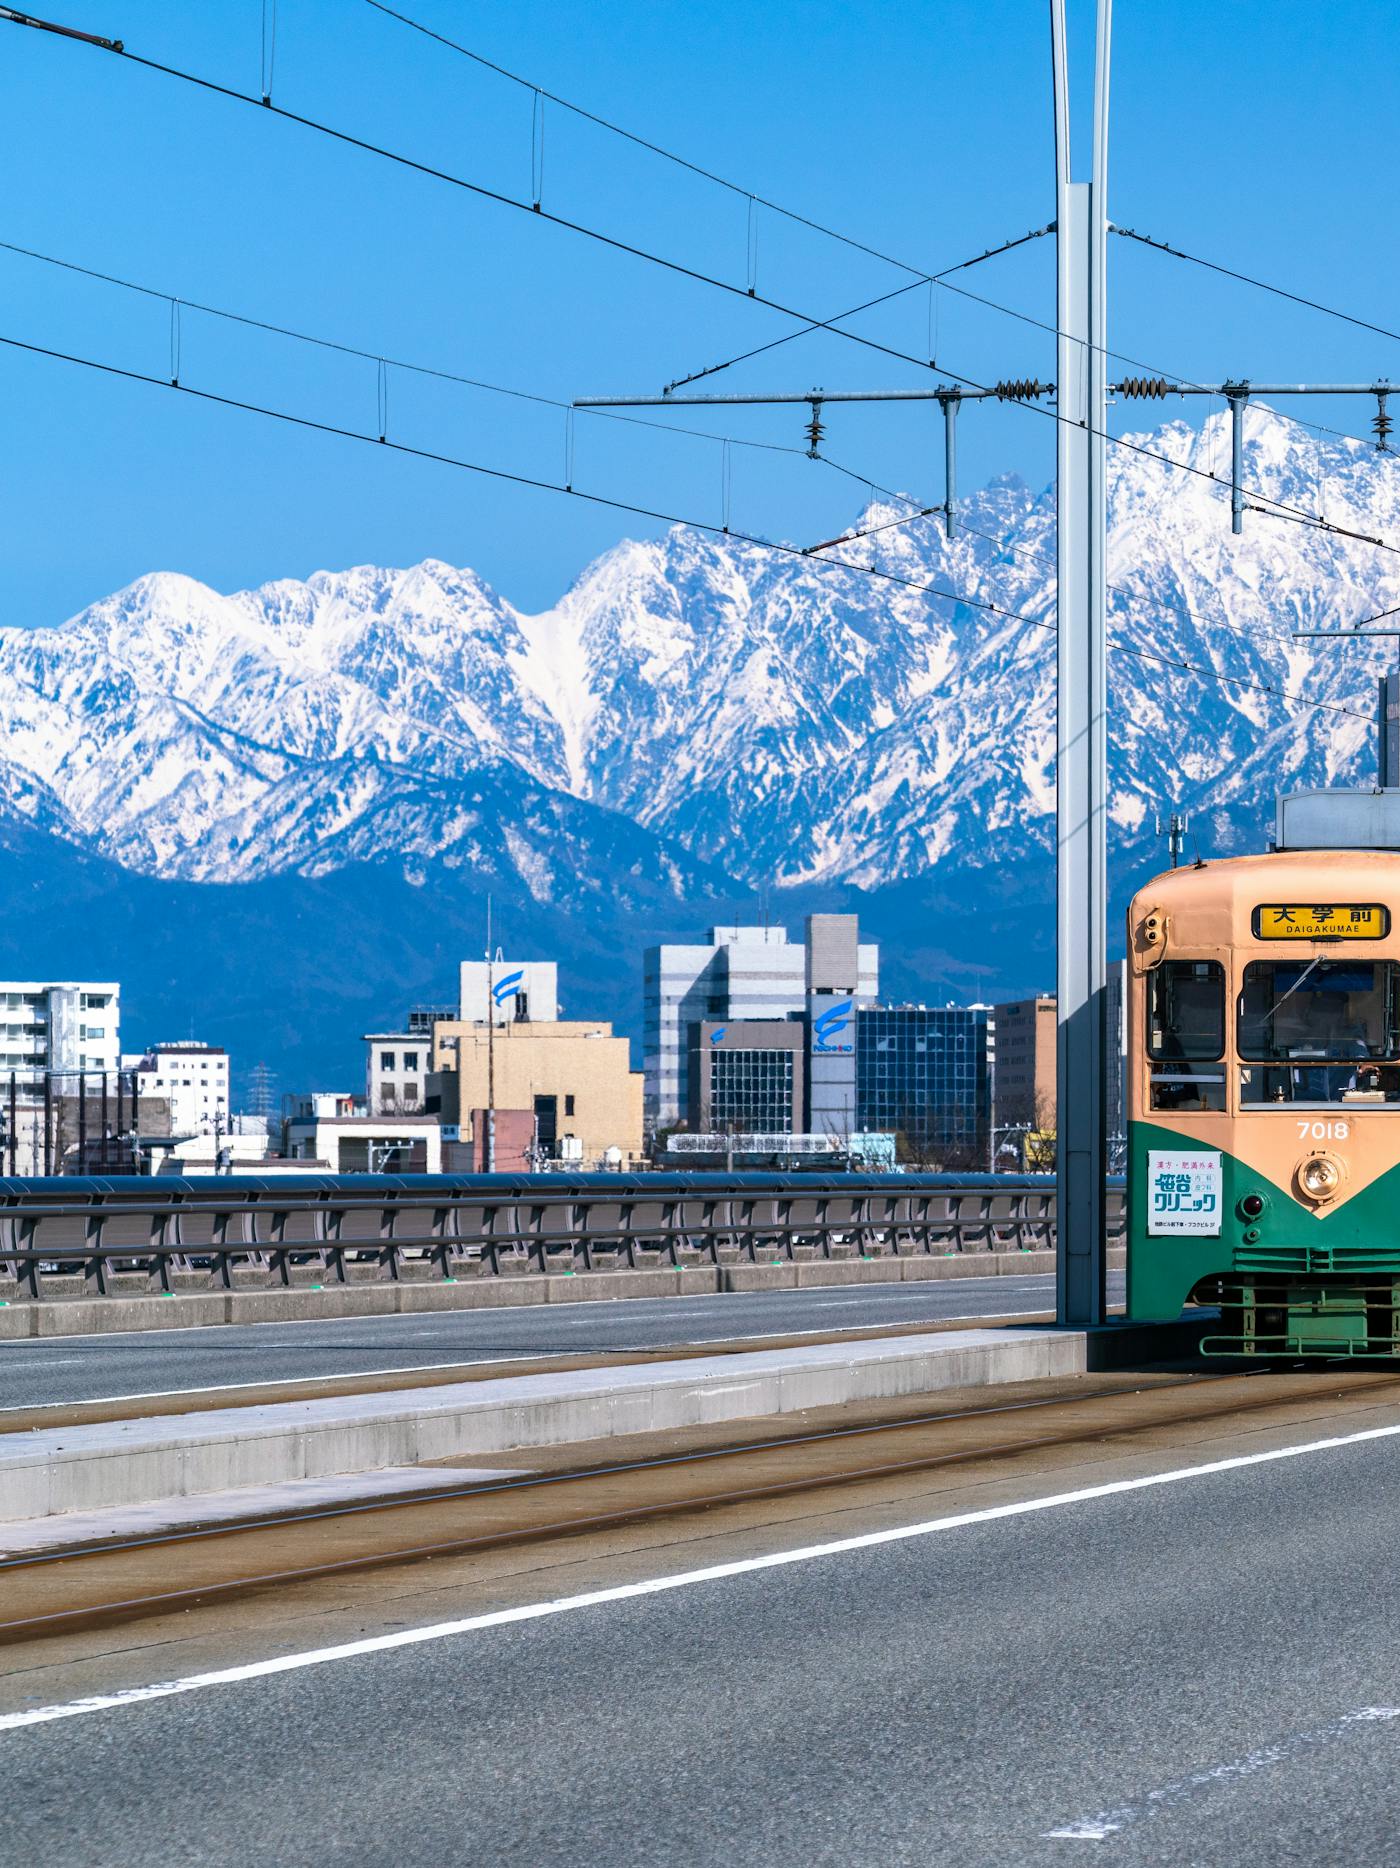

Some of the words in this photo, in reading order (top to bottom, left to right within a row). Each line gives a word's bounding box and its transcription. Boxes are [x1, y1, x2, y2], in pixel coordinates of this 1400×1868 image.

[1273, 907, 1373, 923] 大学前
[1286, 925, 1360, 933] DAIGAKUMAE
[1296, 1122, 1349, 1140] 7018
[1156, 1161, 1215, 1170] 漢方・肥満外来
[1154, 1173, 1192, 1193] 笹谷
[1154, 1193, 1216, 1212] クリニック
